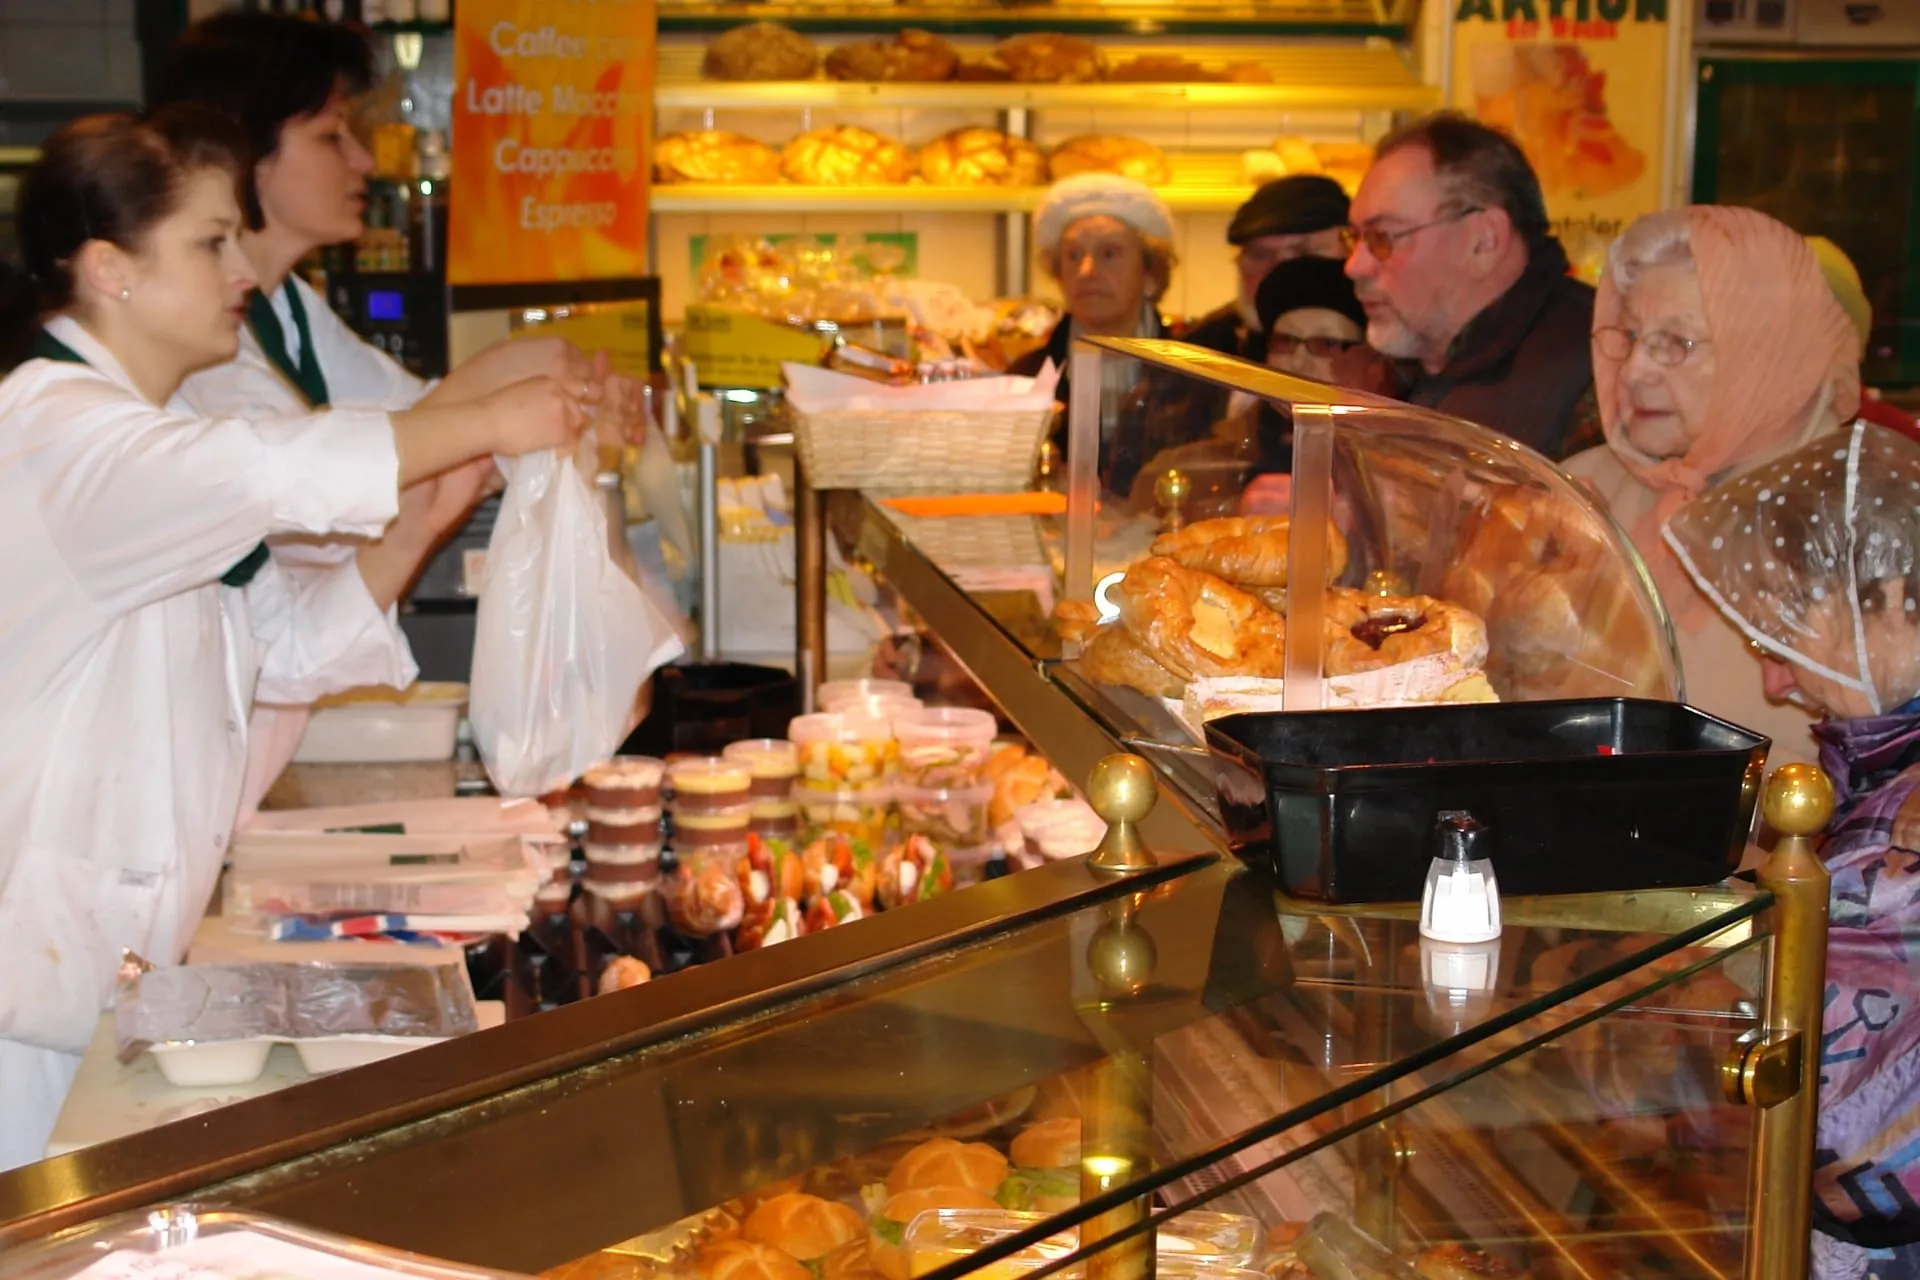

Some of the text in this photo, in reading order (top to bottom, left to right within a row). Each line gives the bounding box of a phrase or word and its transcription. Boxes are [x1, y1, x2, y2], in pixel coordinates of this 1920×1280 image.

[490, 21, 586, 58] Caffee
[467, 77, 626, 117] Latte Macc
[494, 138, 626, 180] Cappucc
